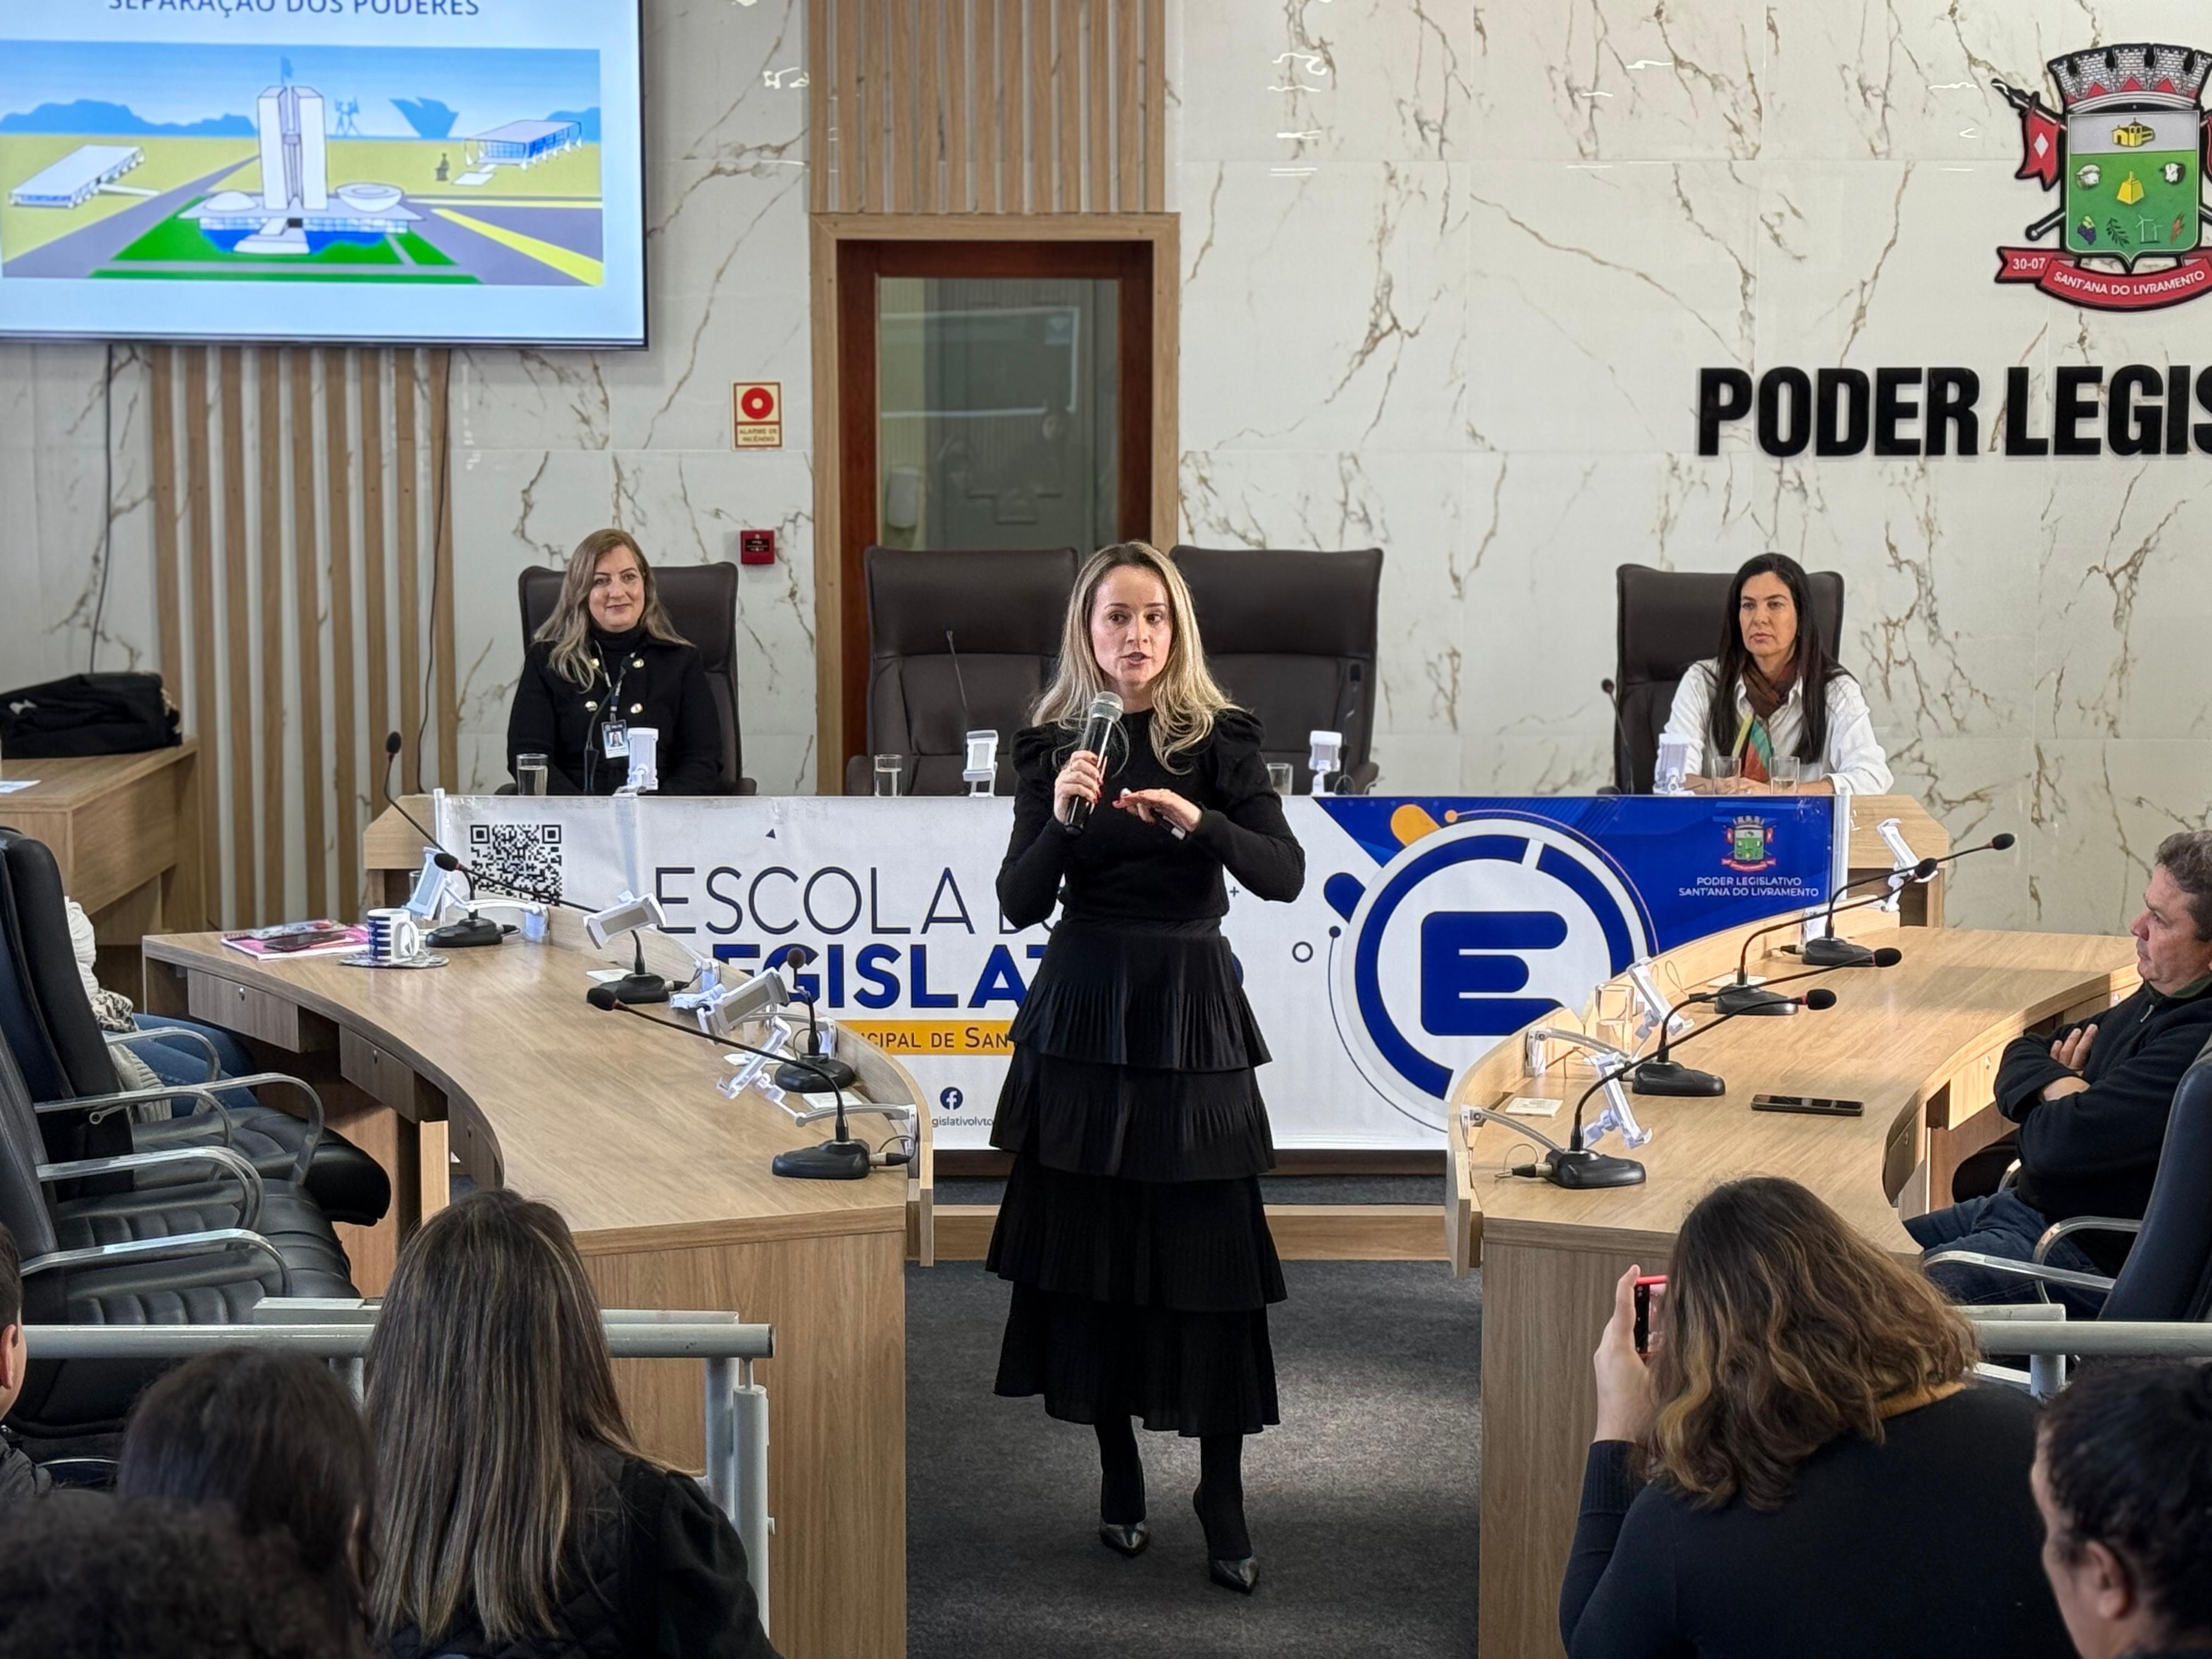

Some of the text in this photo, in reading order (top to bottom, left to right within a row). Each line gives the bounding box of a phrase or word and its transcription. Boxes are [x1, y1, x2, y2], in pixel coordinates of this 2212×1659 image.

[287, 0, 343, 13] DOS
[354, 0, 479, 15] PODERES
[2012, 257, 2046, 270] 30-07
[2111, 284, 2130, 296] DO
[2133, 270, 2205, 296] LIVRAMENTO
[1698, 366, 1980, 458] PODER
[1697, 876, 1802, 887] PODER LEGISLATIVO
[656, 866, 975, 934] ESCOLA
[1733, 887, 1749, 896] DO
[1751, 887, 1819, 898] LIVRAMENTO
[861, 1032, 922, 1048] CIPAL
[931, 1032, 955, 1048] DE
